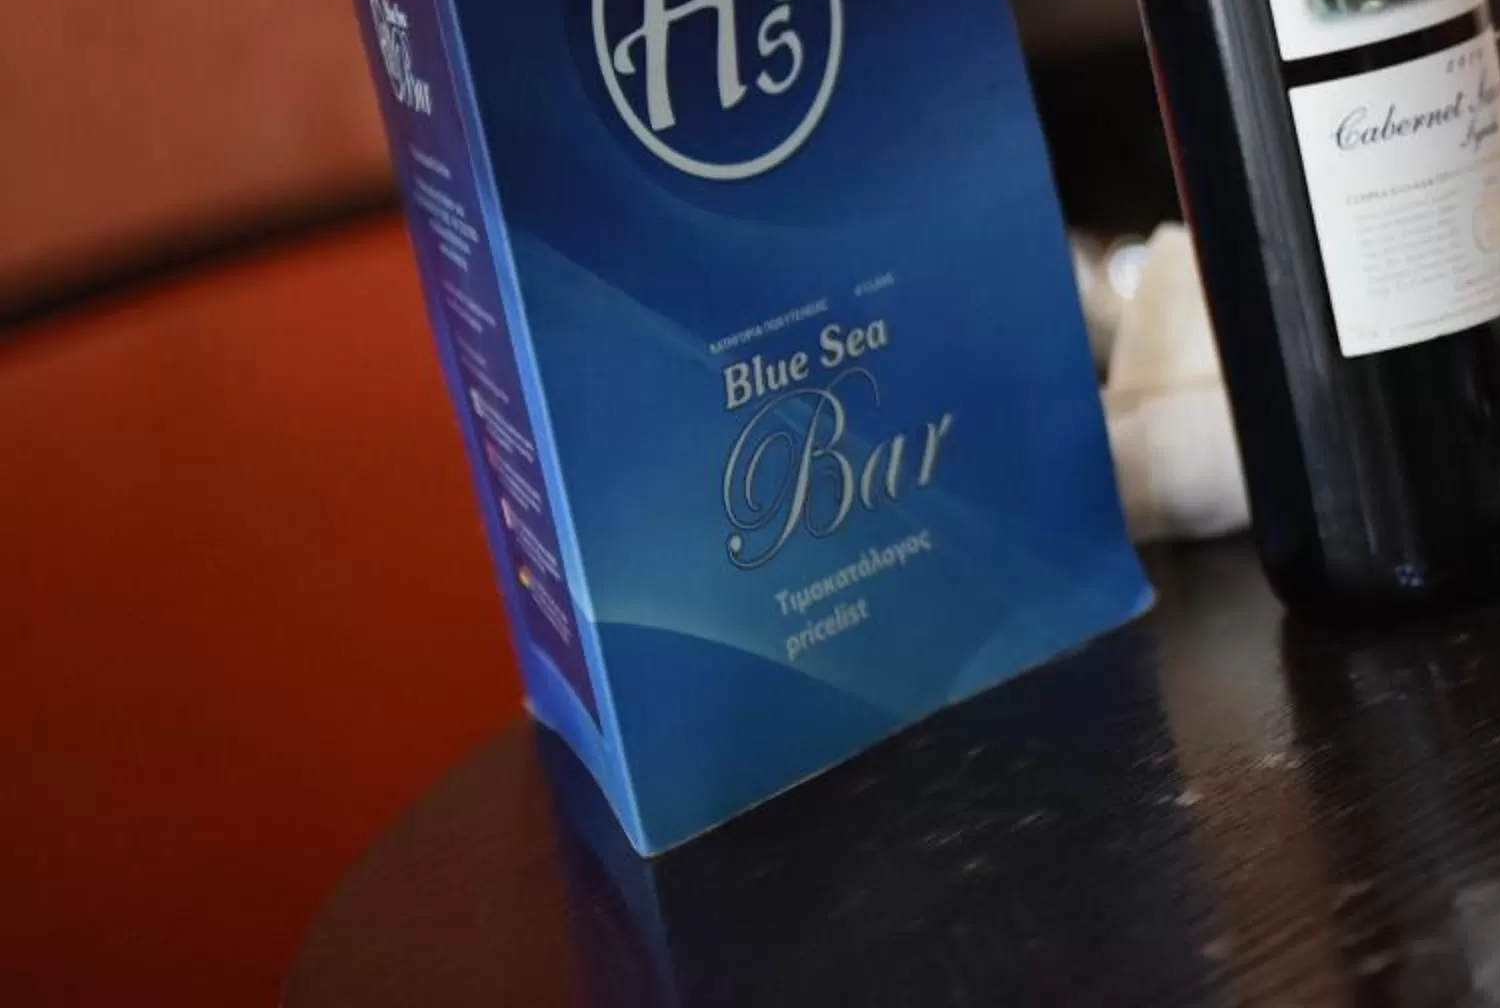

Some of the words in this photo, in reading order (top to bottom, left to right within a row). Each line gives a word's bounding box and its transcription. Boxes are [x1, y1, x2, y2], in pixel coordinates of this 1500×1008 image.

[1333, 90, 1464, 152] Cabernet
[723, 350, 809, 410] Blue
[819, 317, 889, 369] Sea
[723, 366, 954, 571] Bar
[774, 529, 932, 617] Τιμοκατάλογος
[785, 597, 870, 661] pricelist
